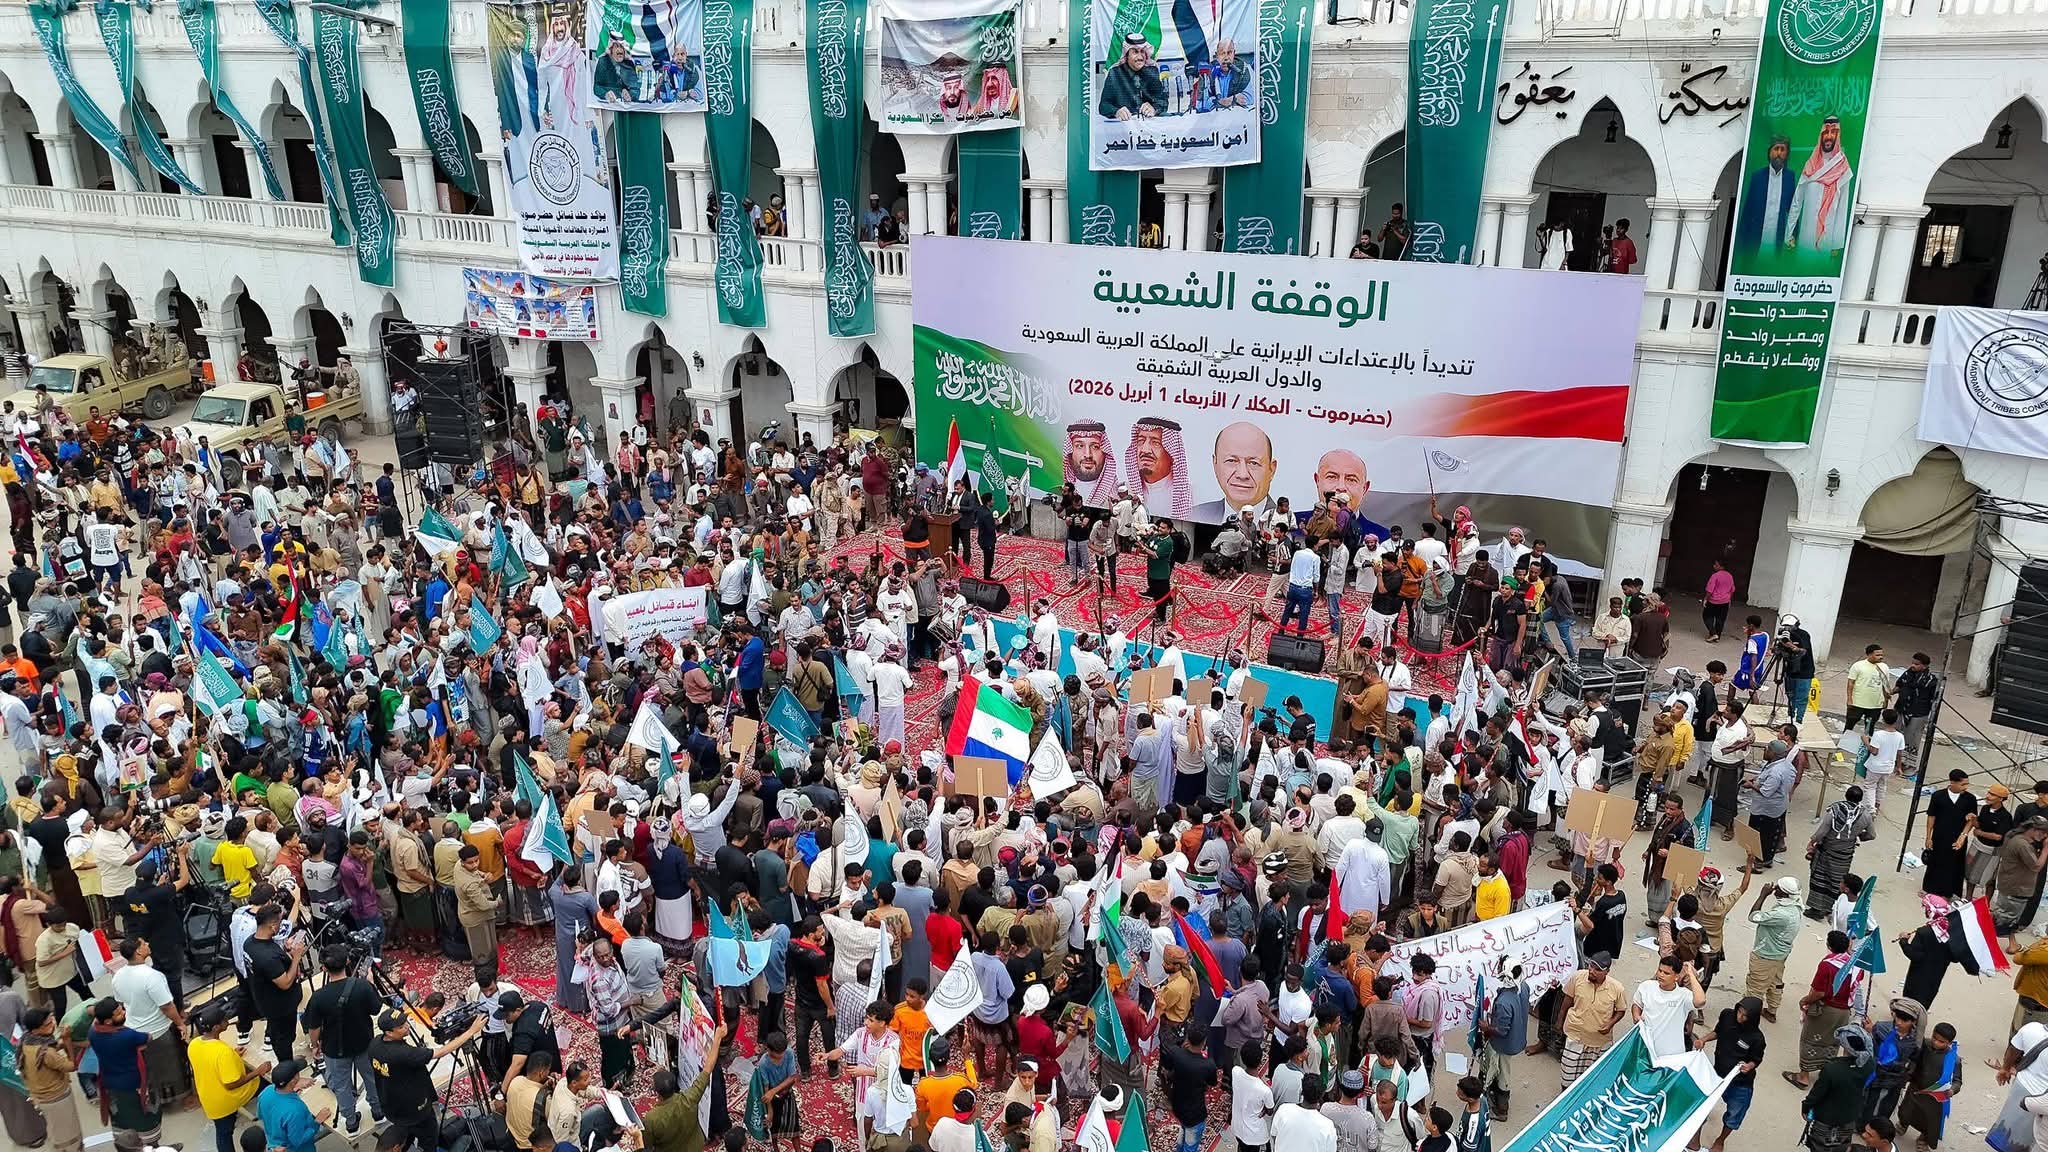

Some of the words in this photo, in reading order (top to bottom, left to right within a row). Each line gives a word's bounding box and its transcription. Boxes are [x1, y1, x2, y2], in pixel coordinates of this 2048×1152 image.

[1782, 13, 1804, 54] HADRAMOUT
[1803, 50, 1830, 59] TRIBES
[1832, 10, 1872, 57] CONFEDERACY
[887, 111, 925, 124] السعودية
[1103, 131, 1133, 154] أحمر
[1160, 131, 1219, 153] السعودية
[1222, 124, 1248, 149] أمن
[1093, 269, 1236, 314] الشعبية
[1734, 279, 1789, 298] والسعودية
[1791, 280, 1832, 298] حضرموت
[1251, 278, 1390, 328] الوقفة
[1729, 304, 1777, 322] واحد
[1779, 308, 1829, 322] جسد
[1022, 323, 1091, 344] السعودية
[1096, 331, 1144, 350] العربية
[1150, 333, 1207, 353] المملكة
[1726, 328, 1769, 346] واحد
[1769, 332, 1824, 347] ومصير
[1251, 342, 1312, 366] الإيرانية
[1318, 347, 1416, 375] بالإعتداءات
[1723, 351, 1769, 370] ينقطع
[1772, 353, 1780, 367] لا
[1780, 353, 1820, 371] ووفاء
[1136, 357, 1202, 378] الشقيقة
[1208, 364, 1259, 384] العربية
[1265, 368, 1322, 391] والدول
[1969, 360, 1991, 405] HADRAMOUT
[1991, 401, 2020, 415] TRIBES
[1119, 381, 1152, 403] أبريل
[1159, 387, 1167, 401] 1
[1174, 388, 1226, 409] الأربعاء
[1245, 395, 1290, 414] المكلا
[1307, 405, 1393, 428] (حضرموت
[648, 599, 675, 614] قبائل
[306, 869, 319, 880] 34
